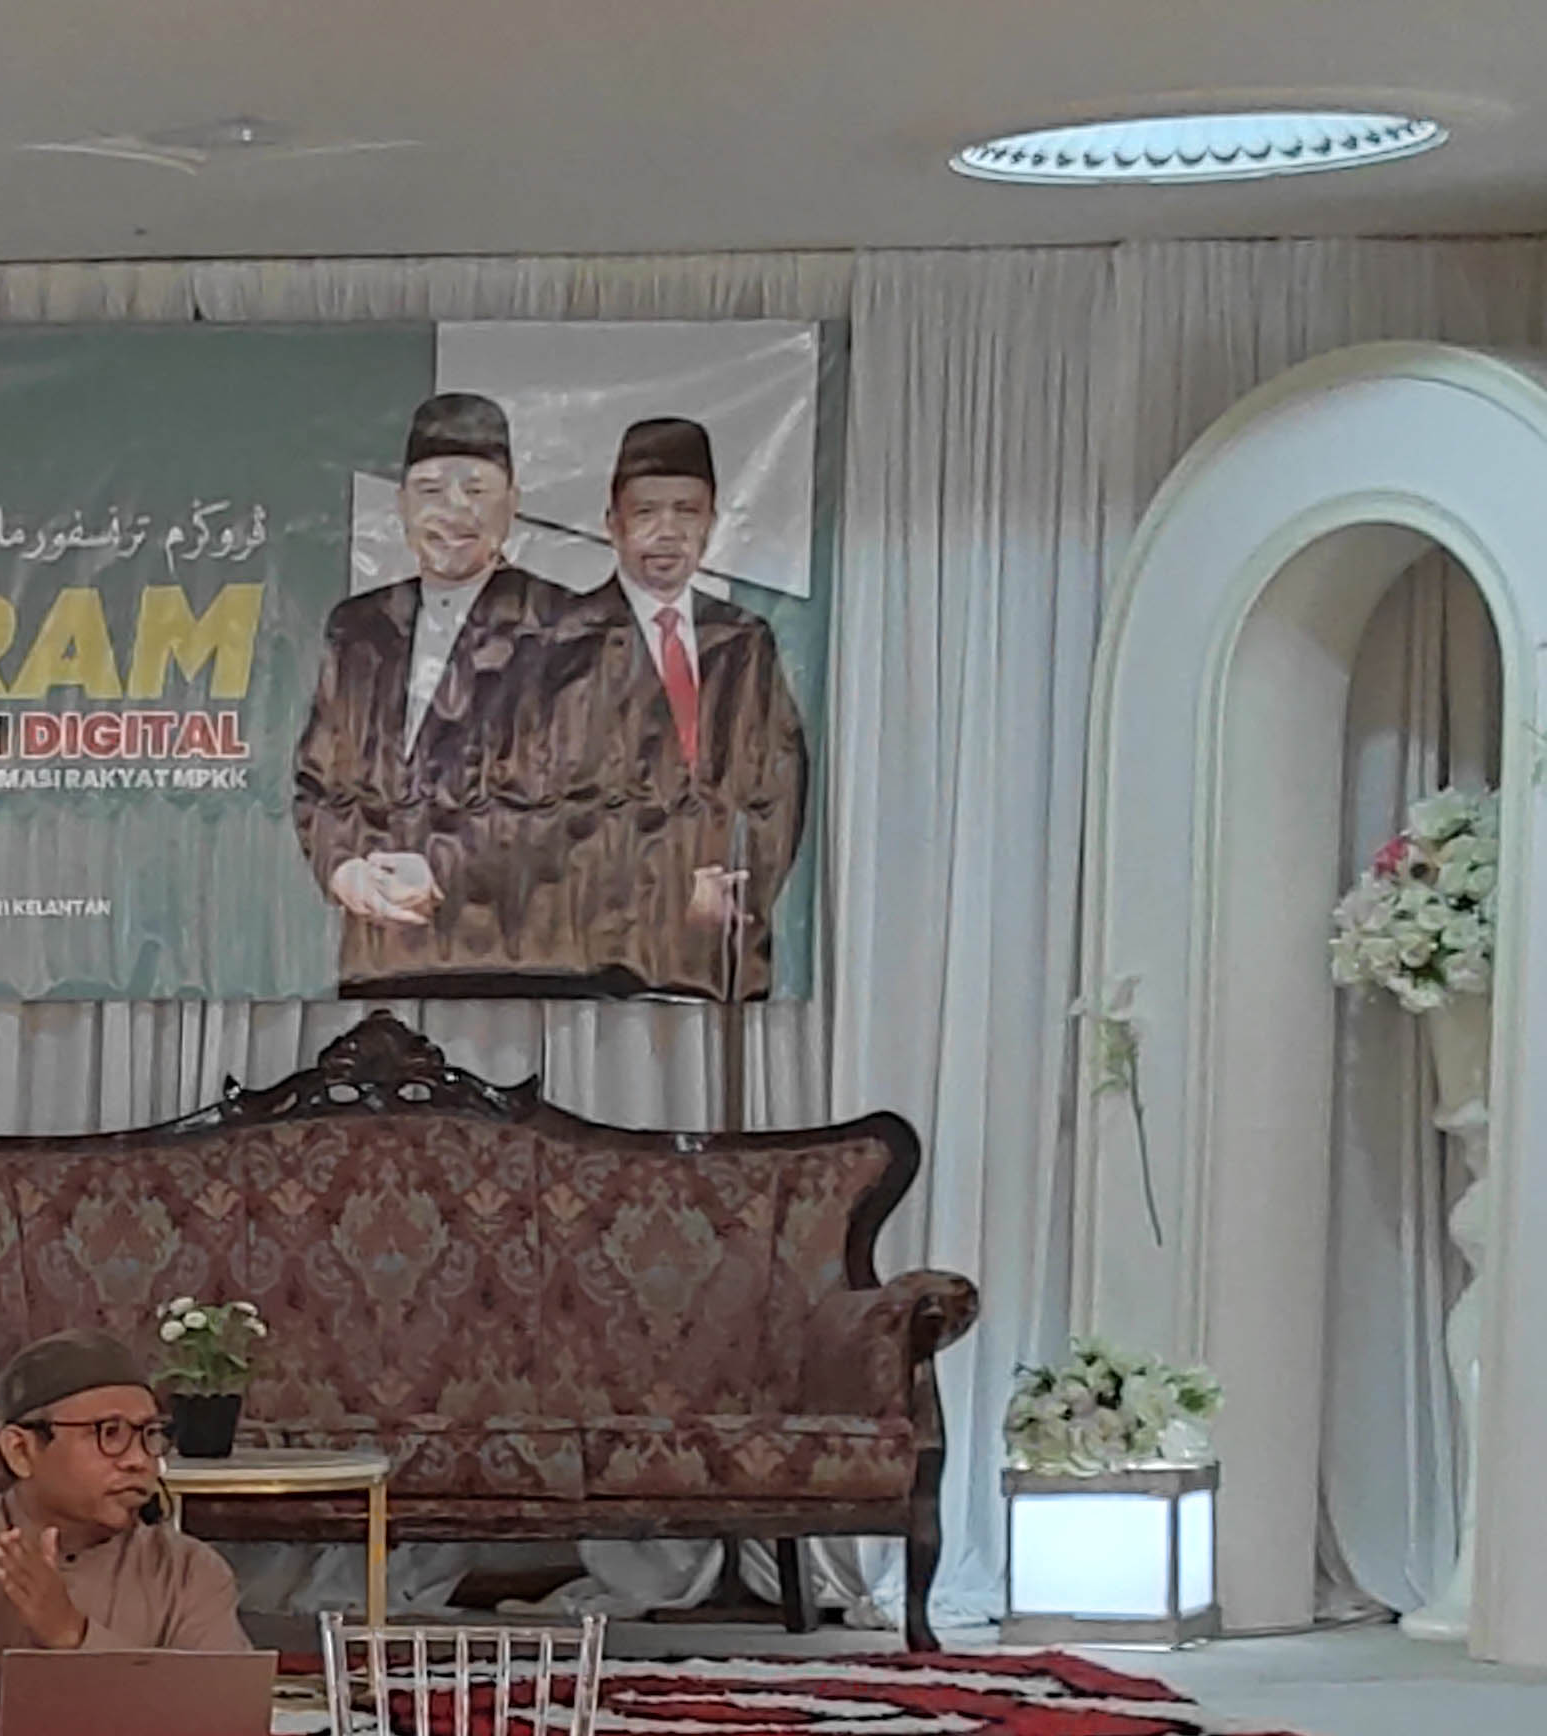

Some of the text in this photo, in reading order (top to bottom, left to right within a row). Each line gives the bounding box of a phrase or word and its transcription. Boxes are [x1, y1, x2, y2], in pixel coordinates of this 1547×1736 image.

[20, 711, 250, 759] DIGITAL
[64, 767, 171, 789] RAKYAT
[173, 767, 248, 789] MPKK
[12, 898, 112, 917] KELANTAN
